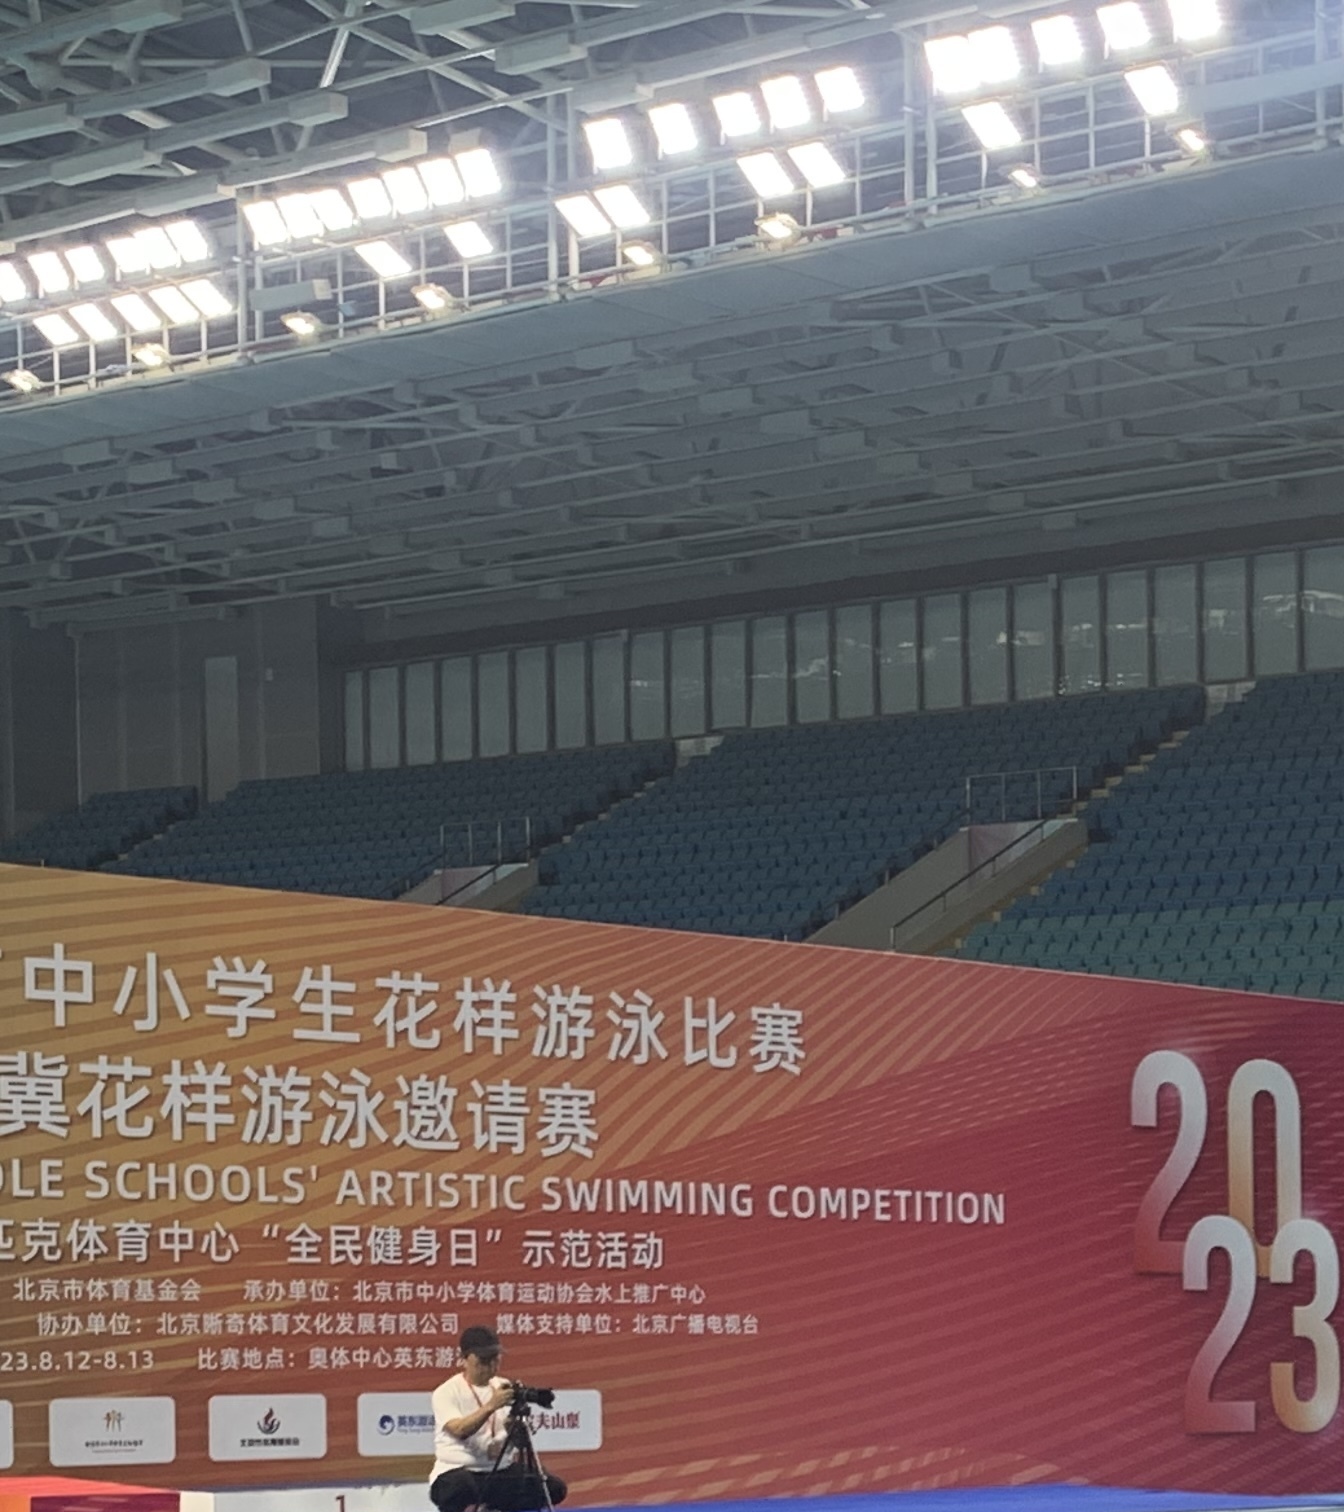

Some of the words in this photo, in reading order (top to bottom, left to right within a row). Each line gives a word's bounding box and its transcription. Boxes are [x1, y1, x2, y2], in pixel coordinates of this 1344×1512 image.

[24, 943, 806, 1077] 中小学生花样游泳比赛
[0, 1050, 599, 1159] 冀花样游泳邀请赛
[0, 1158, 65, 1198] LE
[85, 1160, 318, 1205] SCHOOLS'
[336, 1169, 526, 1211] ARTISTIC
[541, 1176, 753, 1218] SWIMMING
[767, 1185, 1005, 1226] COMPETITION
[13, 1278, 202, 1302] 北京市体育基金会
[0, 1350, 154, 1371] 23.8.12-8.13
